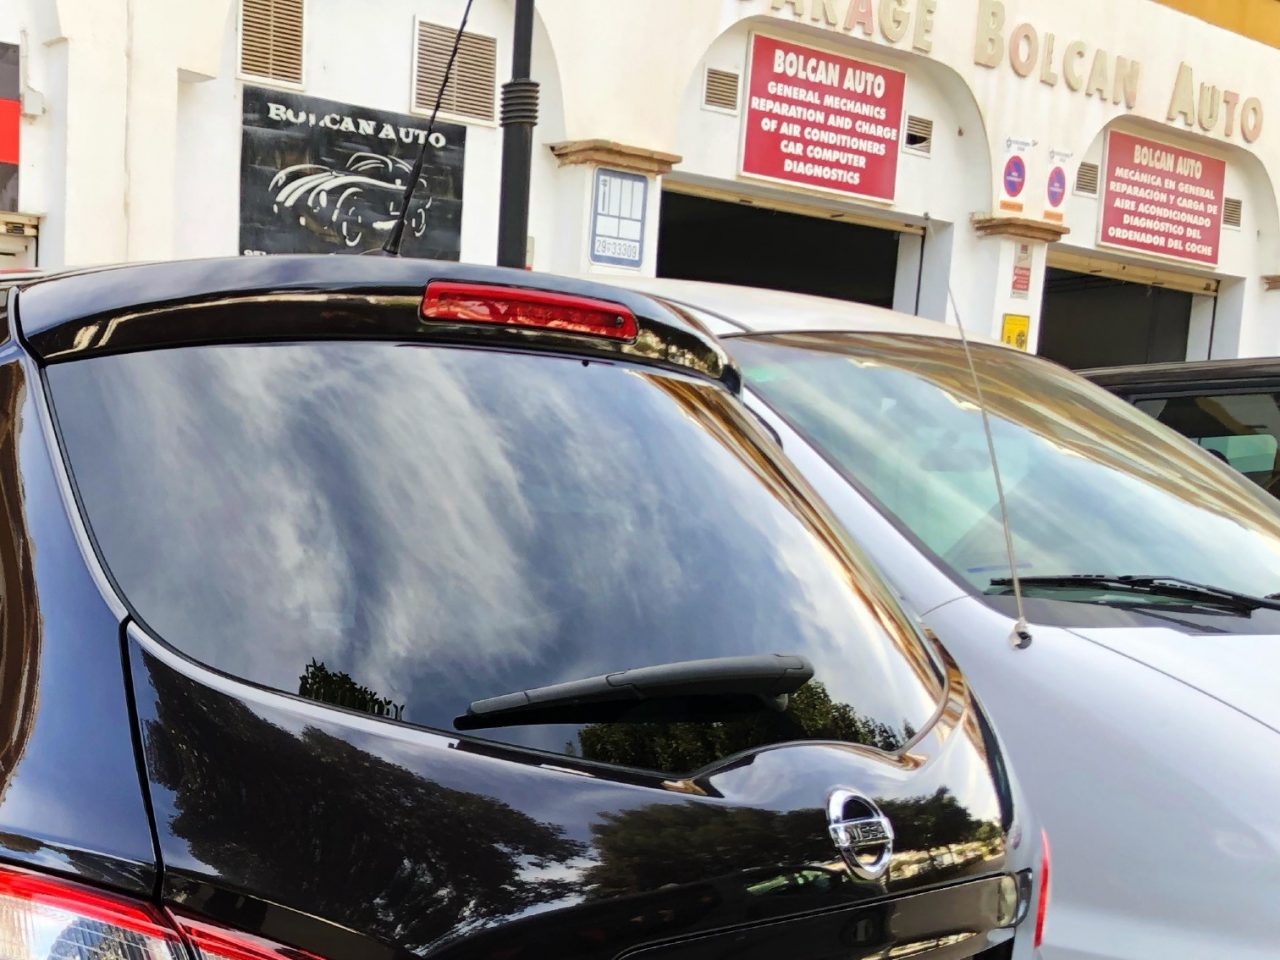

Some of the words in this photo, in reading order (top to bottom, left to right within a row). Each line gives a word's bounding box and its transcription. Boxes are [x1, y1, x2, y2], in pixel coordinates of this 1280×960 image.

[773, 48, 840, 87] BOLCAN
[843, 67, 886, 99] AUTO
[974, 0, 1140, 109] BOLCAN
[1167, 61, 1263, 144] AUTO
[767, 81, 821, 105] GENERAL
[823, 94, 887, 120] MECHANICS
[751, 96, 825, 124] REPARATION
[827, 114, 852, 130] AND
[855, 120, 898, 141] CHARGE
[378, 123, 447, 148] AUTO
[761, 118, 778, 132] OF
[779, 122, 801, 137] AIR
[804, 127, 886, 156] CONDITIONERS
[780, 140, 803, 156] CAR
[806, 145, 866, 168] COMPUTER
[1133, 144, 1175, 172] BOLCAN
[1176, 156, 1203, 180] AUTO
[783, 159, 860, 185] DIAGNOSTICS
[1164, 178, 1176, 190] EN
[1178, 182, 1215, 200] GENERAL
[1113, 197, 1137, 211] AIRE
[1137, 203, 1211, 228] ACONDICIONADO
[1169, 195, 1175, 205] Y
[1177, 197, 1205, 212] CARGA
[1207, 204, 1218, 215] DE
[1108, 226, 1165, 247] ORDENADOR
[1167, 237, 1183, 250] DEL
[1185, 241, 1213, 256] COCHE
[1186, 227, 1202, 239] DEL
